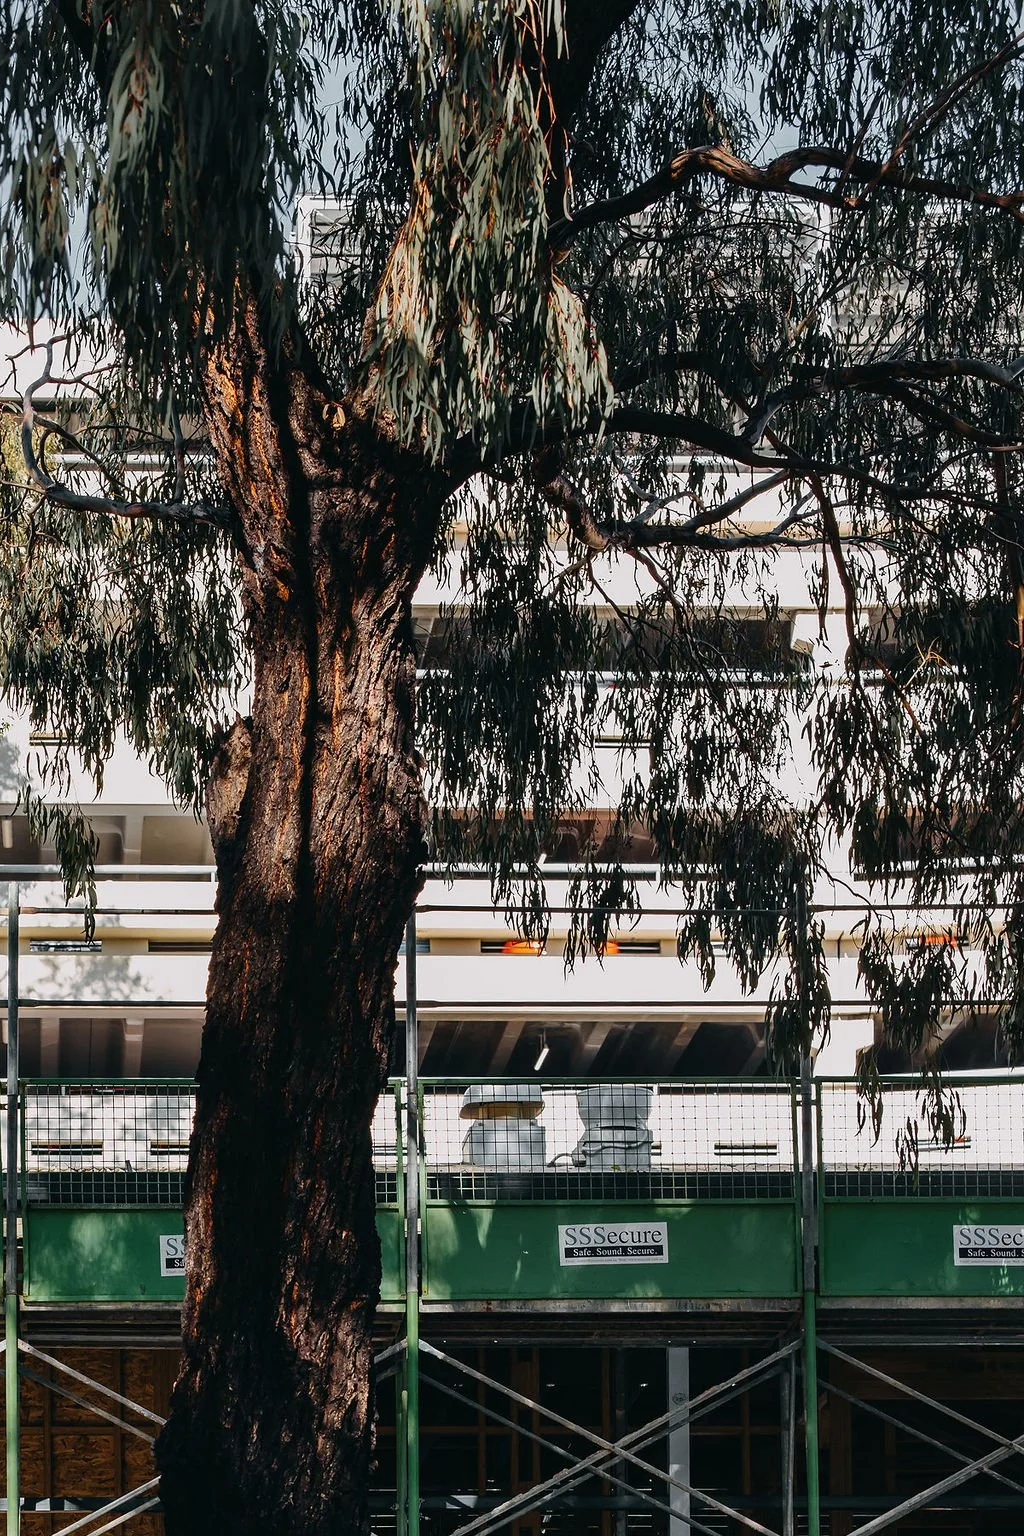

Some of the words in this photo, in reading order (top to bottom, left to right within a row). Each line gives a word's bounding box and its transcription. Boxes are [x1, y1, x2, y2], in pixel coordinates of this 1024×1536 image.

[565, 1226, 663, 1246] SSSecure
[573, 1248, 594, 1257] Safe.
[596, 1247, 625, 1256] Sound.
[627, 1246, 658, 1255] Secure.
[967, 1248, 988, 1257] Safe.
[990, 1248, 1019, 1257] Sound.
